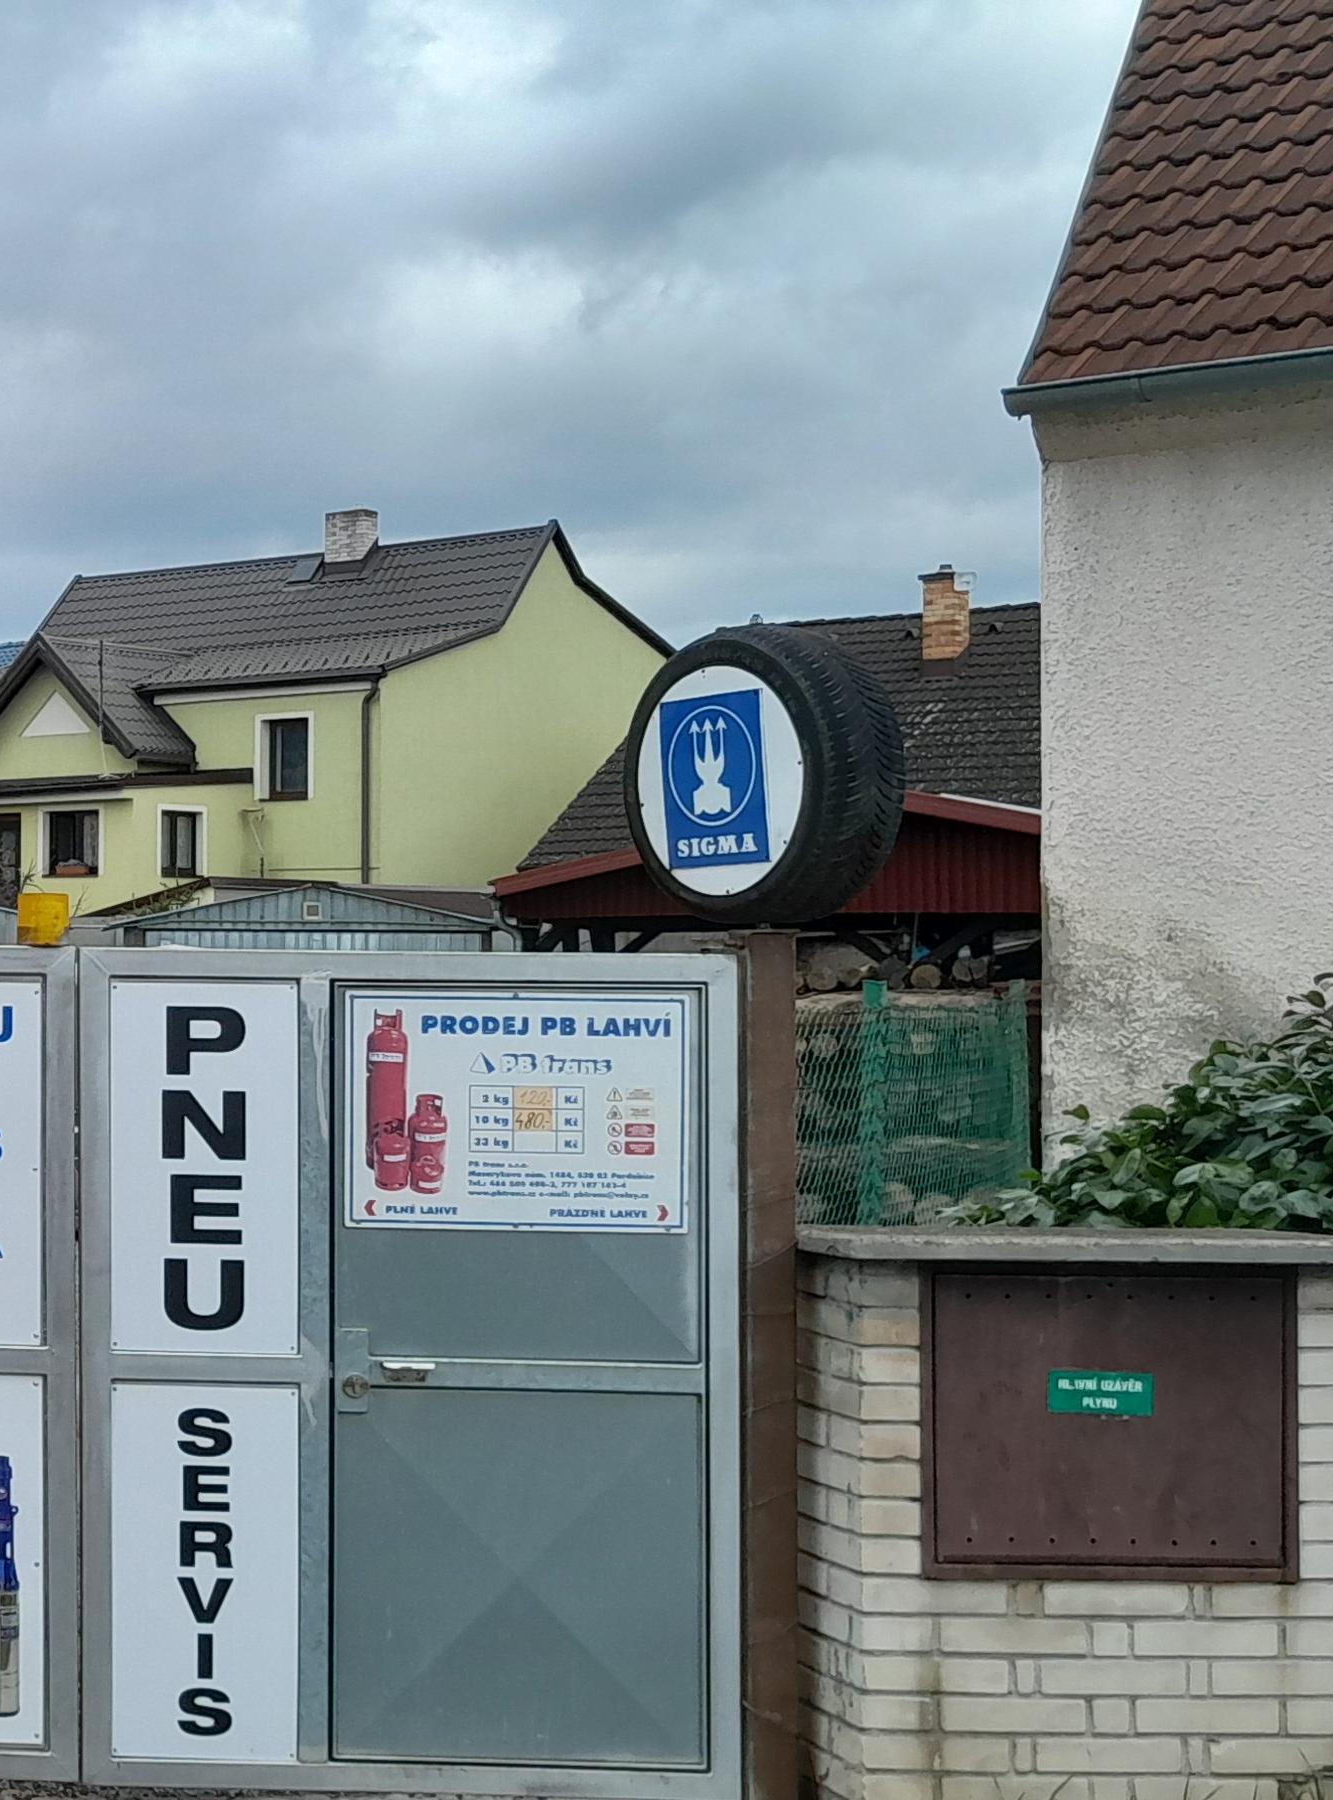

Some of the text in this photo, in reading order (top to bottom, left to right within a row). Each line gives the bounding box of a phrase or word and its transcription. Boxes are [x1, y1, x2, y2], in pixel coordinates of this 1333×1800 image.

[677, 833, 758, 858] SIGMA
[421, 1012, 671, 1037] PRODEJ PB LAHVÍ
[499, 1053, 613, 1076] PB trans
[482, 1094, 509, 1105] 2 kg
[475, 1115, 509, 1127] 10 kg
[494, 1138, 509, 1149] kg
[161, 1005, 246, 1330] PNEU
[385, 1203, 416, 1215] PLNÉ
[420, 1205, 458, 1215] LAHVE
[610, 1209, 648, 1219] LAHVE
[1081, 1396, 1118, 1409] PLYNU
[176, 1408, 233, 1736] SERVIS
